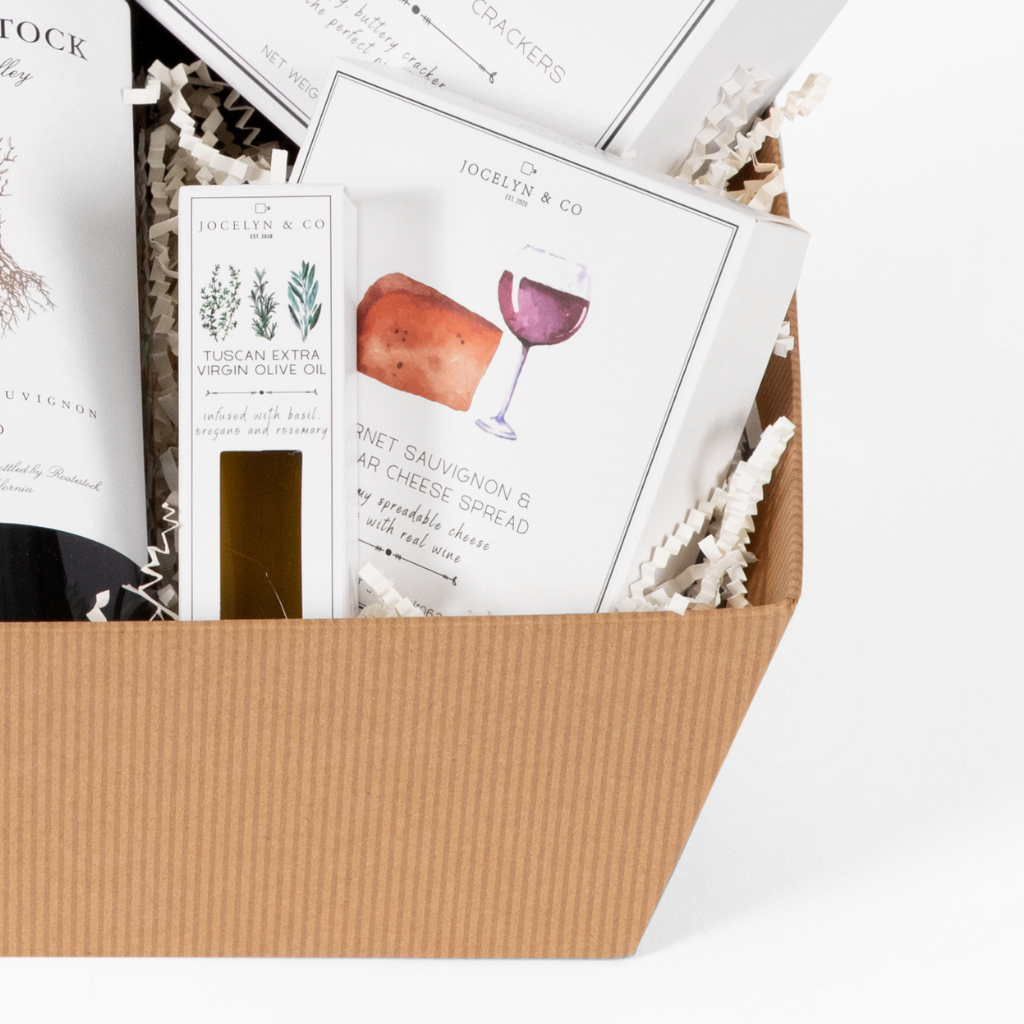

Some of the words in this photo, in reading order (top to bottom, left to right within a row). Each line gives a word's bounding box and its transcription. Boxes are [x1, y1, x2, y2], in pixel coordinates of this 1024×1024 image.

[325, 18, 375, 55] perfect
[354, 4, 399, 52] buttery
[402, 52, 446, 88] cracker
[261, 44, 287, 69] NET
[289, 68, 319, 99] WEIG
[459, 160, 534, 197] JOCELYN
[541, 192, 551, 204] &
[560, 199, 582, 215] CO
[505, 194, 514, 202] EST.
[516, 198, 528, 207] 2020
[198, 220, 272, 233] JOCELYN
[283, 221, 292, 229] &
[303, 219, 325, 229] CO
[197, 365, 248, 375] VIRGIN
[255, 364, 296, 374] OLIVE
[304, 364, 326, 374] OIL
[204, 350, 265, 361] TUSCAN
[272, 350, 320, 360] EXTRA
[196, 427, 240, 441] oregano
[248, 420, 269, 436] and
[276, 427, 328, 440] rosemary
[203, 406, 248, 422] infused
[254, 406, 280, 421] with
[29, 464, 43, 479] by
[46, 465, 102, 491] Routestock
[357, 423, 398, 452] RNET
[404, 445, 512, 501] SAUVIGNON
[518, 493, 531, 509] &
[386, 464, 453, 503] CHEESE
[459, 495, 529, 535] SPREAD
[366, 517, 396, 535] with
[400, 534, 429, 548] real
[432, 544, 461, 563] wine
[378, 497, 442, 530] spreadable
[449, 522, 490, 551] cheese
